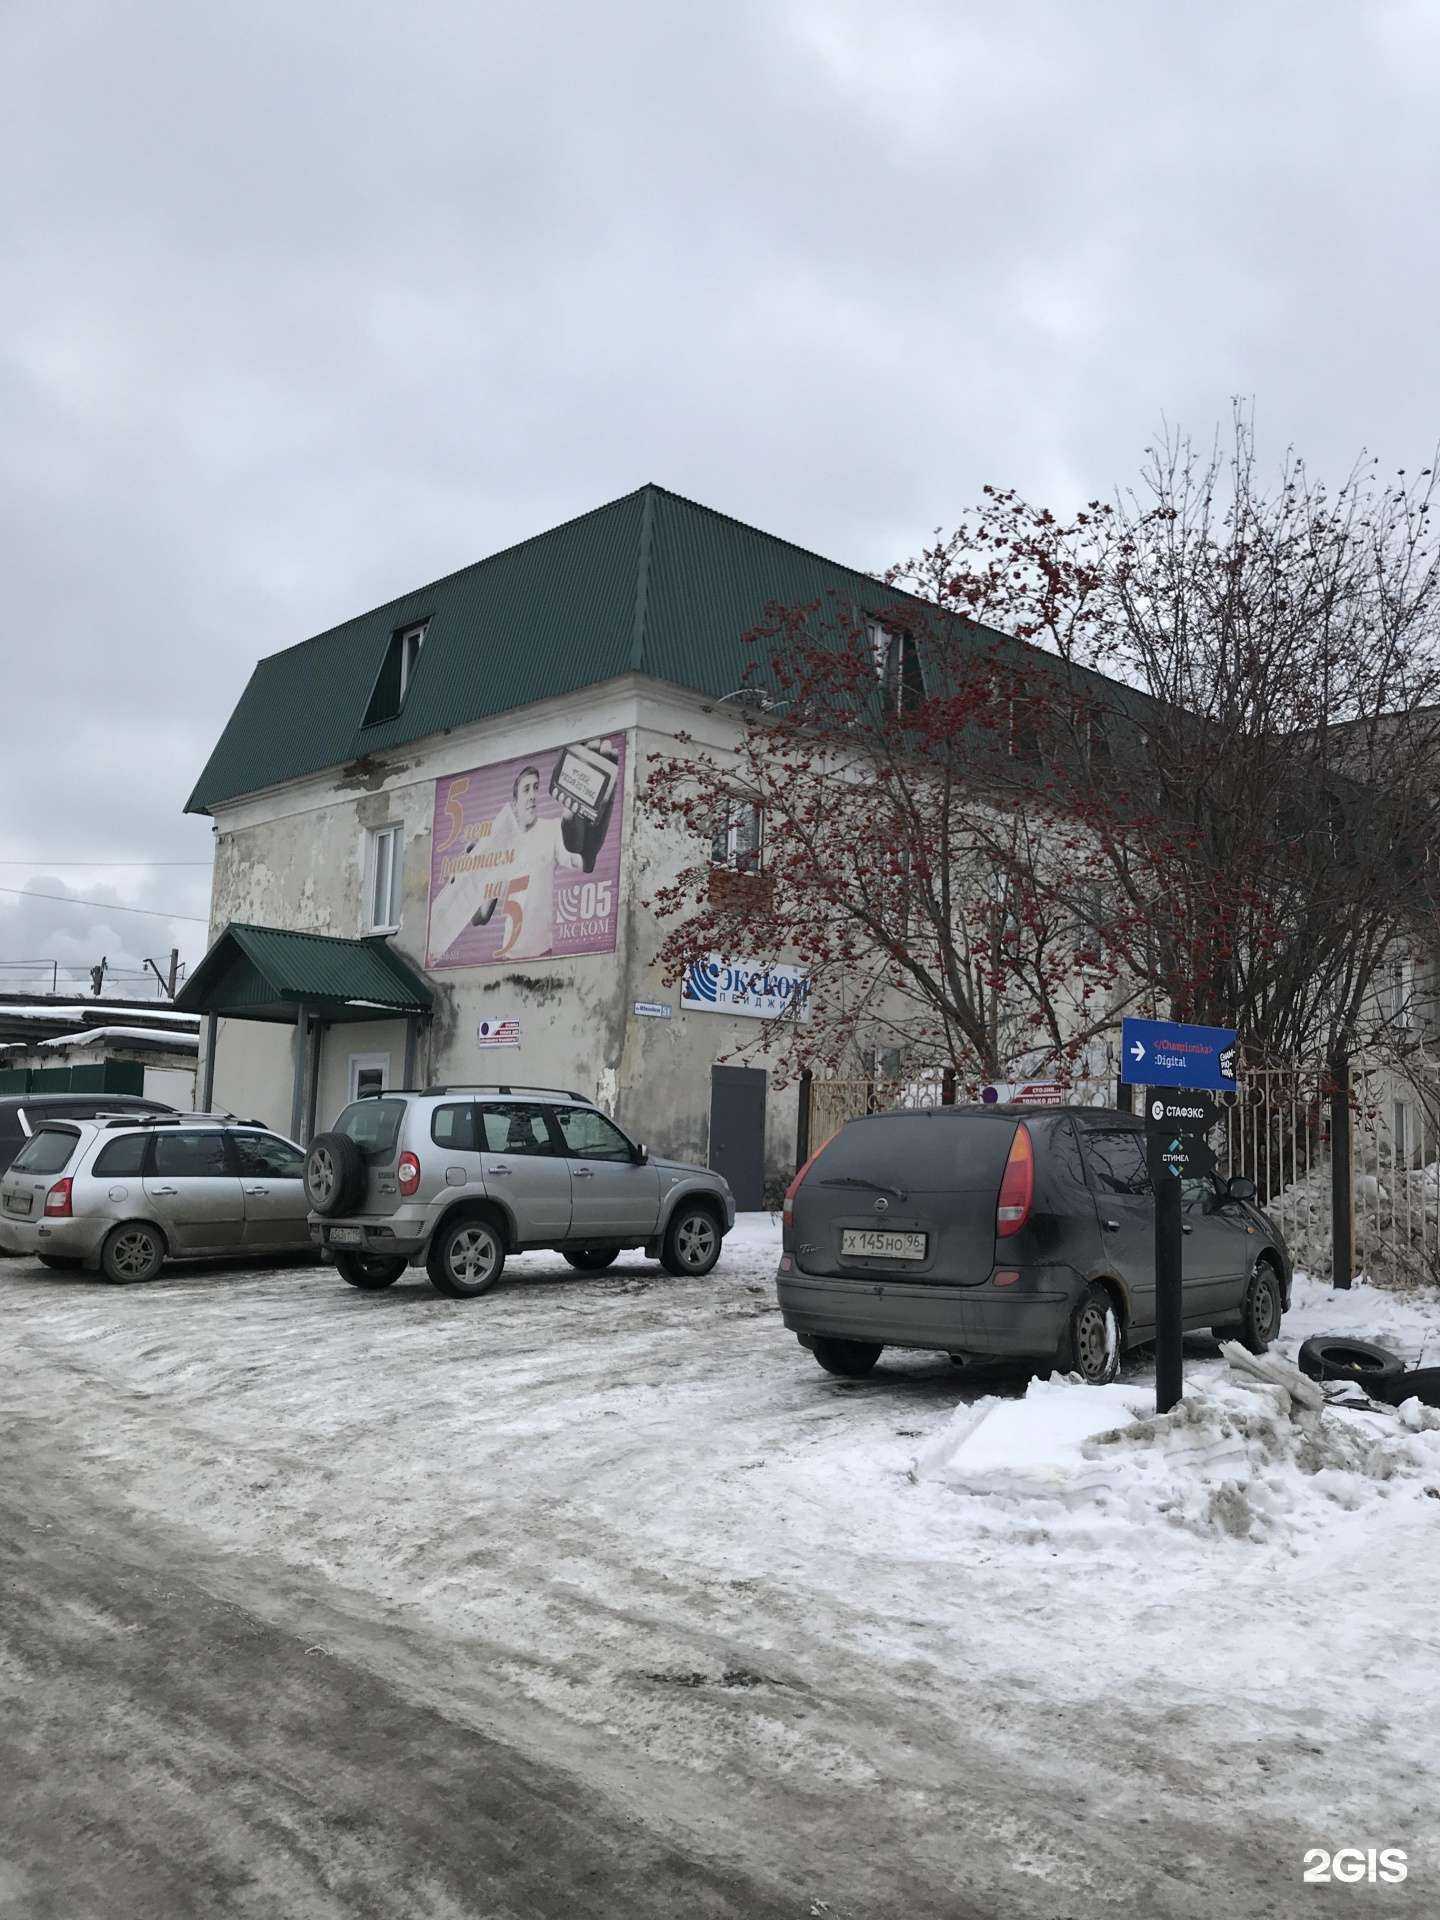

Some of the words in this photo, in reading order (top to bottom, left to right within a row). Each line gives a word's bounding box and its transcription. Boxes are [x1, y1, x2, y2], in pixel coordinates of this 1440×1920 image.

[437, 778, 470, 852] 5
[493, 874, 530, 958] 5
[1166, 1105, 1204, 1119] СТАФЭКС
